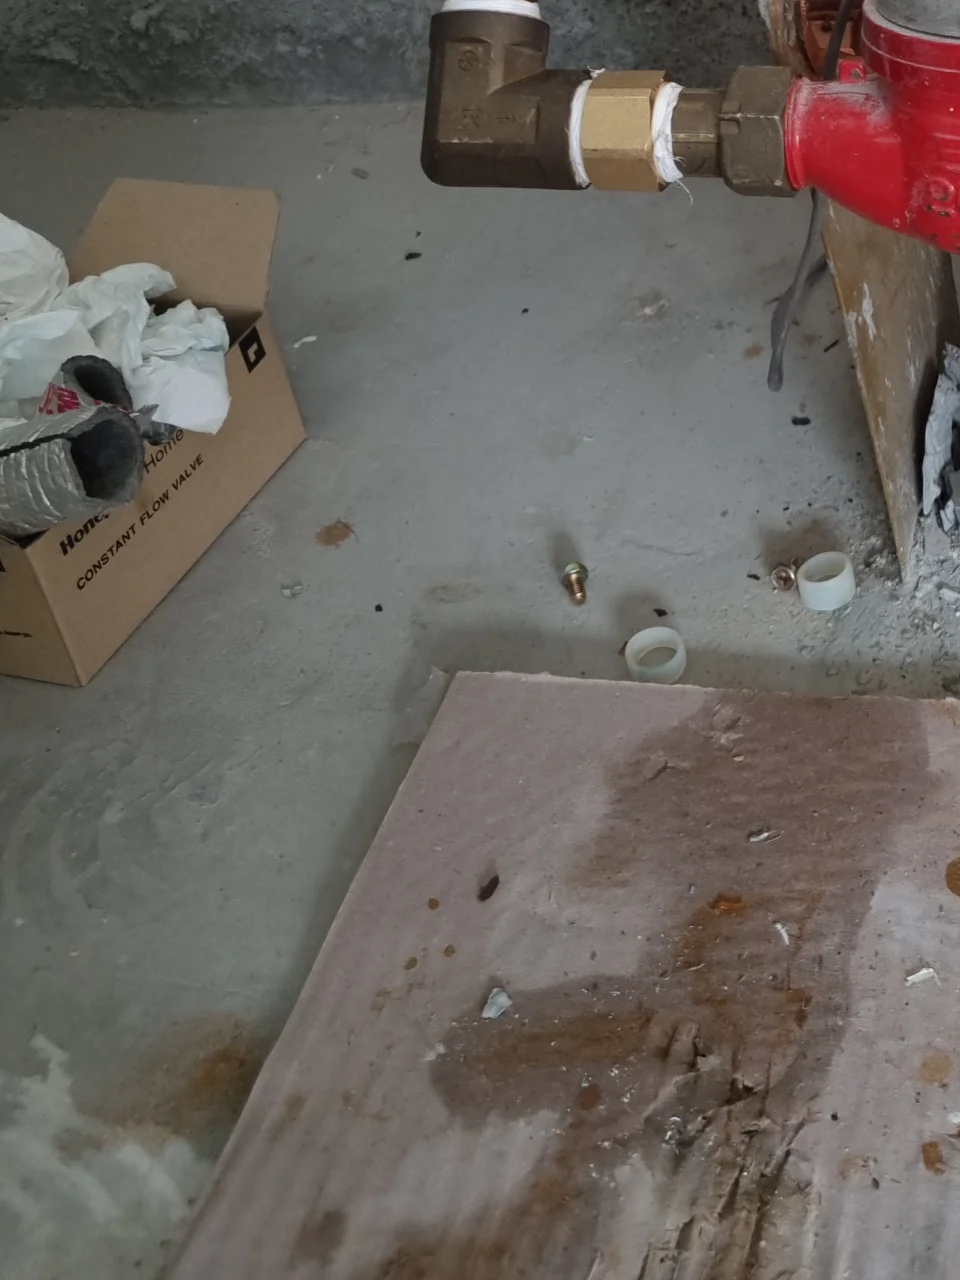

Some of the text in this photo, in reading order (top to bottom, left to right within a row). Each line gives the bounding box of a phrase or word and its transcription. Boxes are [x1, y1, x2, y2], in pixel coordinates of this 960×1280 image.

[76, 454, 204, 590] CONSTANT FLOW VALVE
